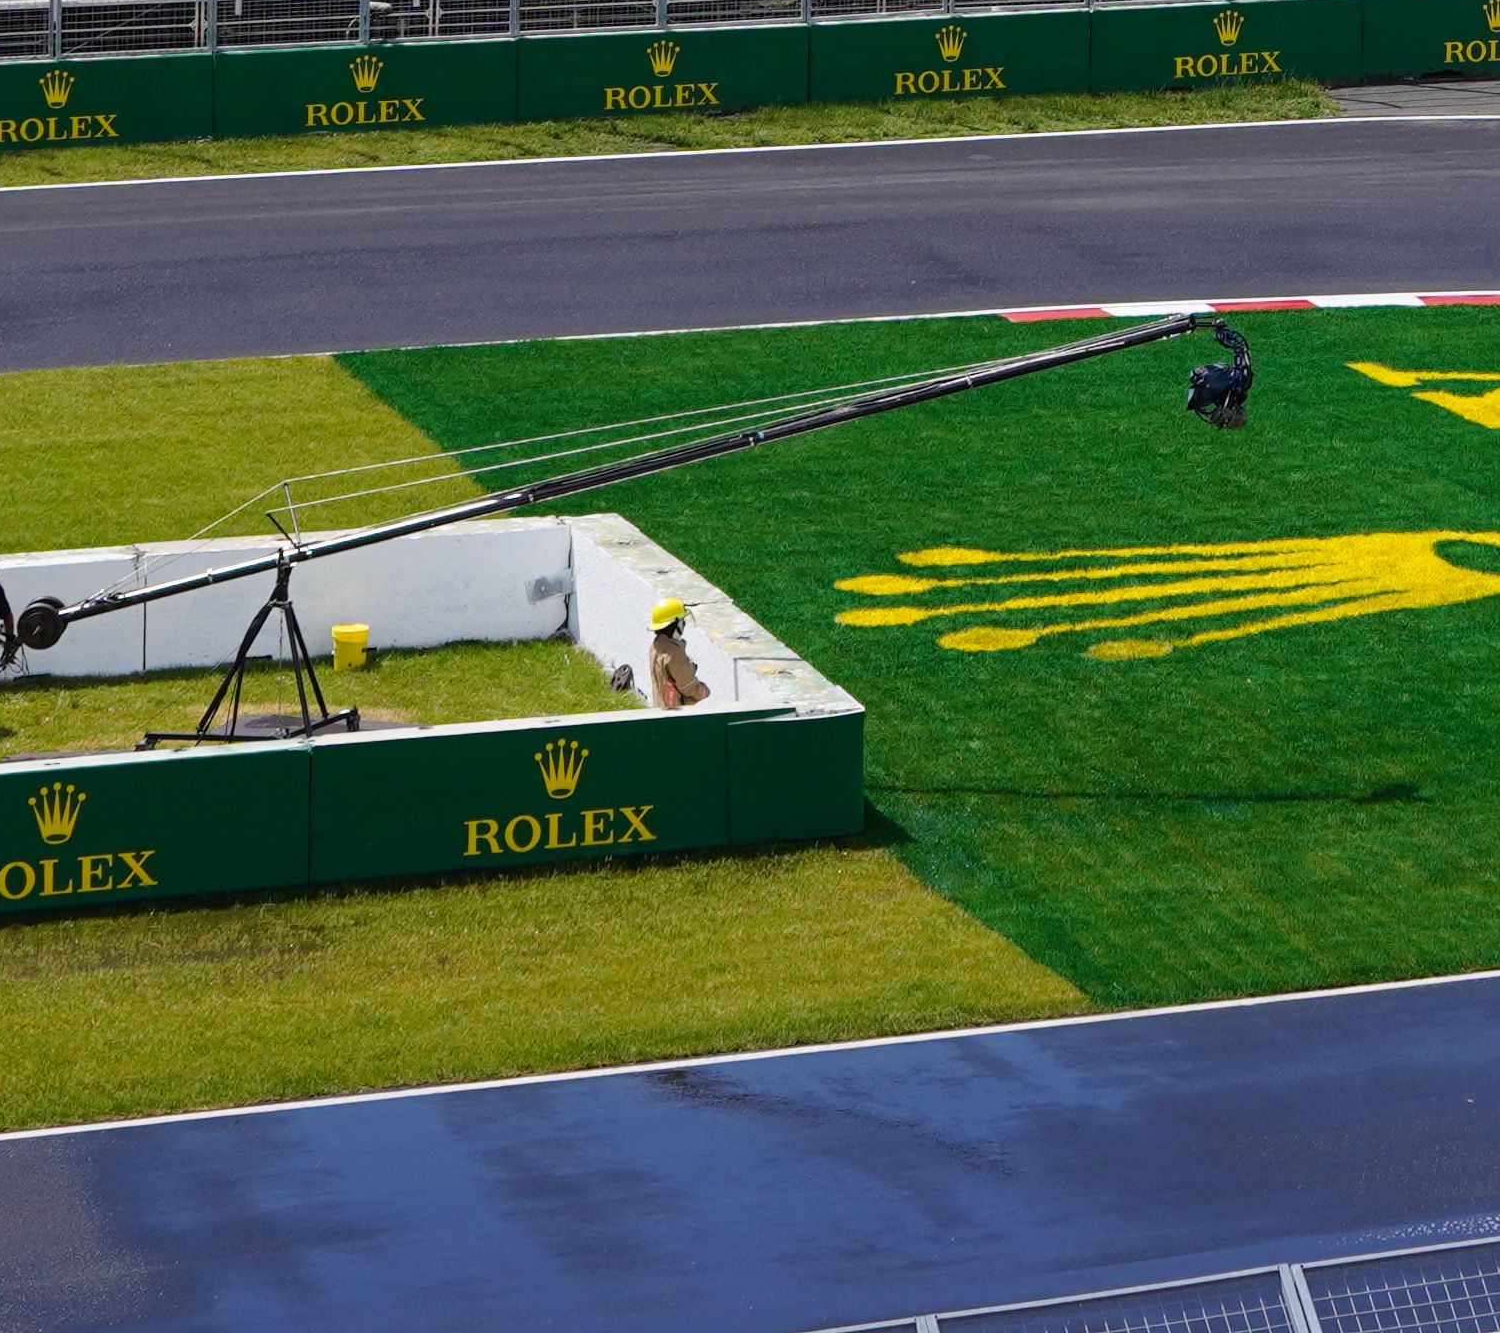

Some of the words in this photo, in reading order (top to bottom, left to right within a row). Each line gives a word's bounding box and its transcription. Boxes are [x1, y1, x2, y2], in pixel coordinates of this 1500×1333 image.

[1173, 51, 1280, 77] ROLEX
[895, 67, 1006, 94] ROLEX
[603, 84, 720, 110] ROLEX
[305, 99, 425, 126] ROLEX
[462, 804, 657, 858] ROLEX
